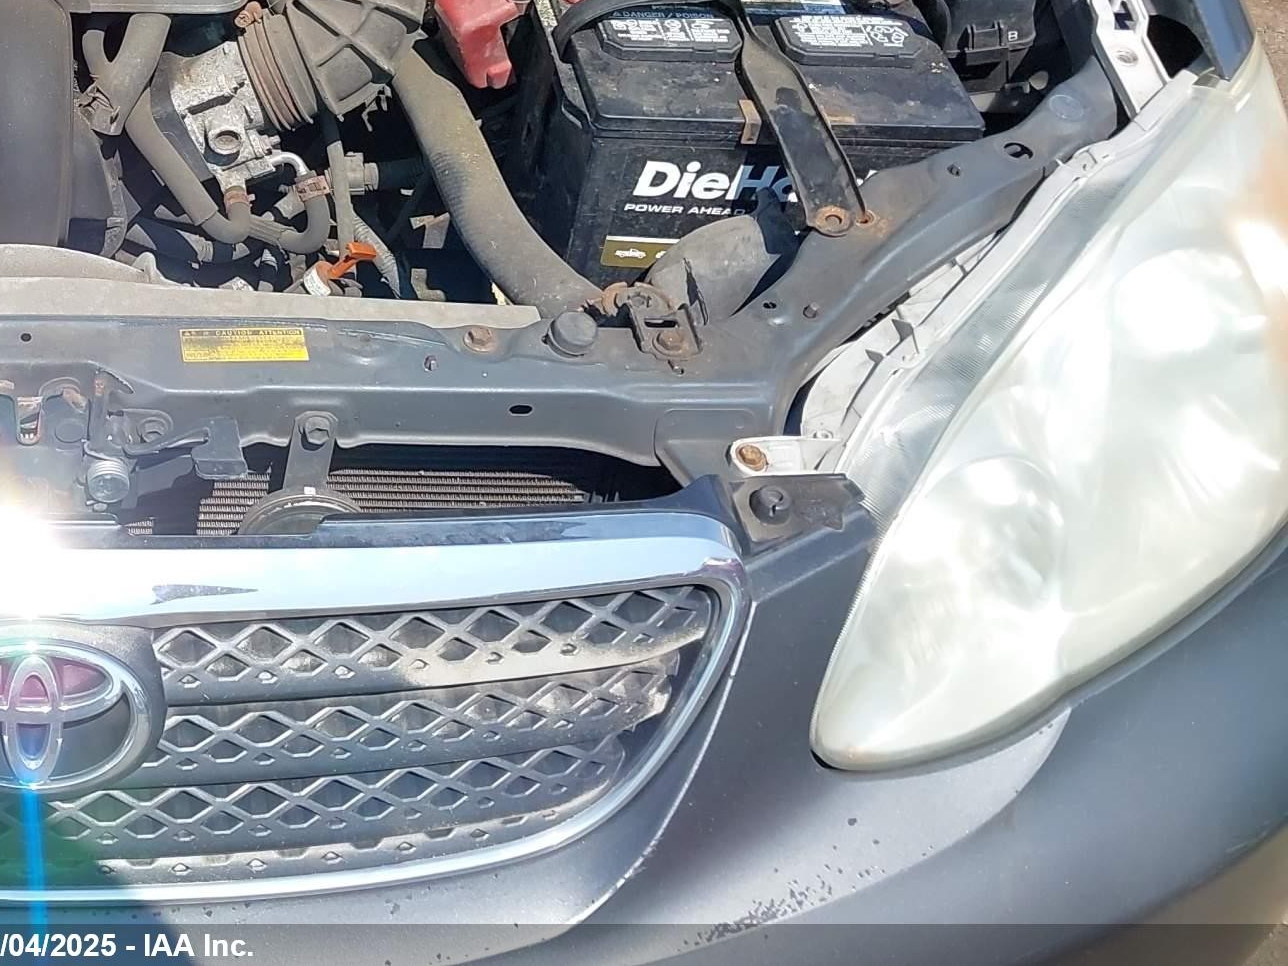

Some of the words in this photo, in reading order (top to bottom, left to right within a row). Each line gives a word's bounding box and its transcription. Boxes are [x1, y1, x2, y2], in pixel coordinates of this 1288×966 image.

[633, 160, 878, 206] DieHa
[624, 203, 683, 215] POWER
[688, 206, 746, 217] AHEAD
